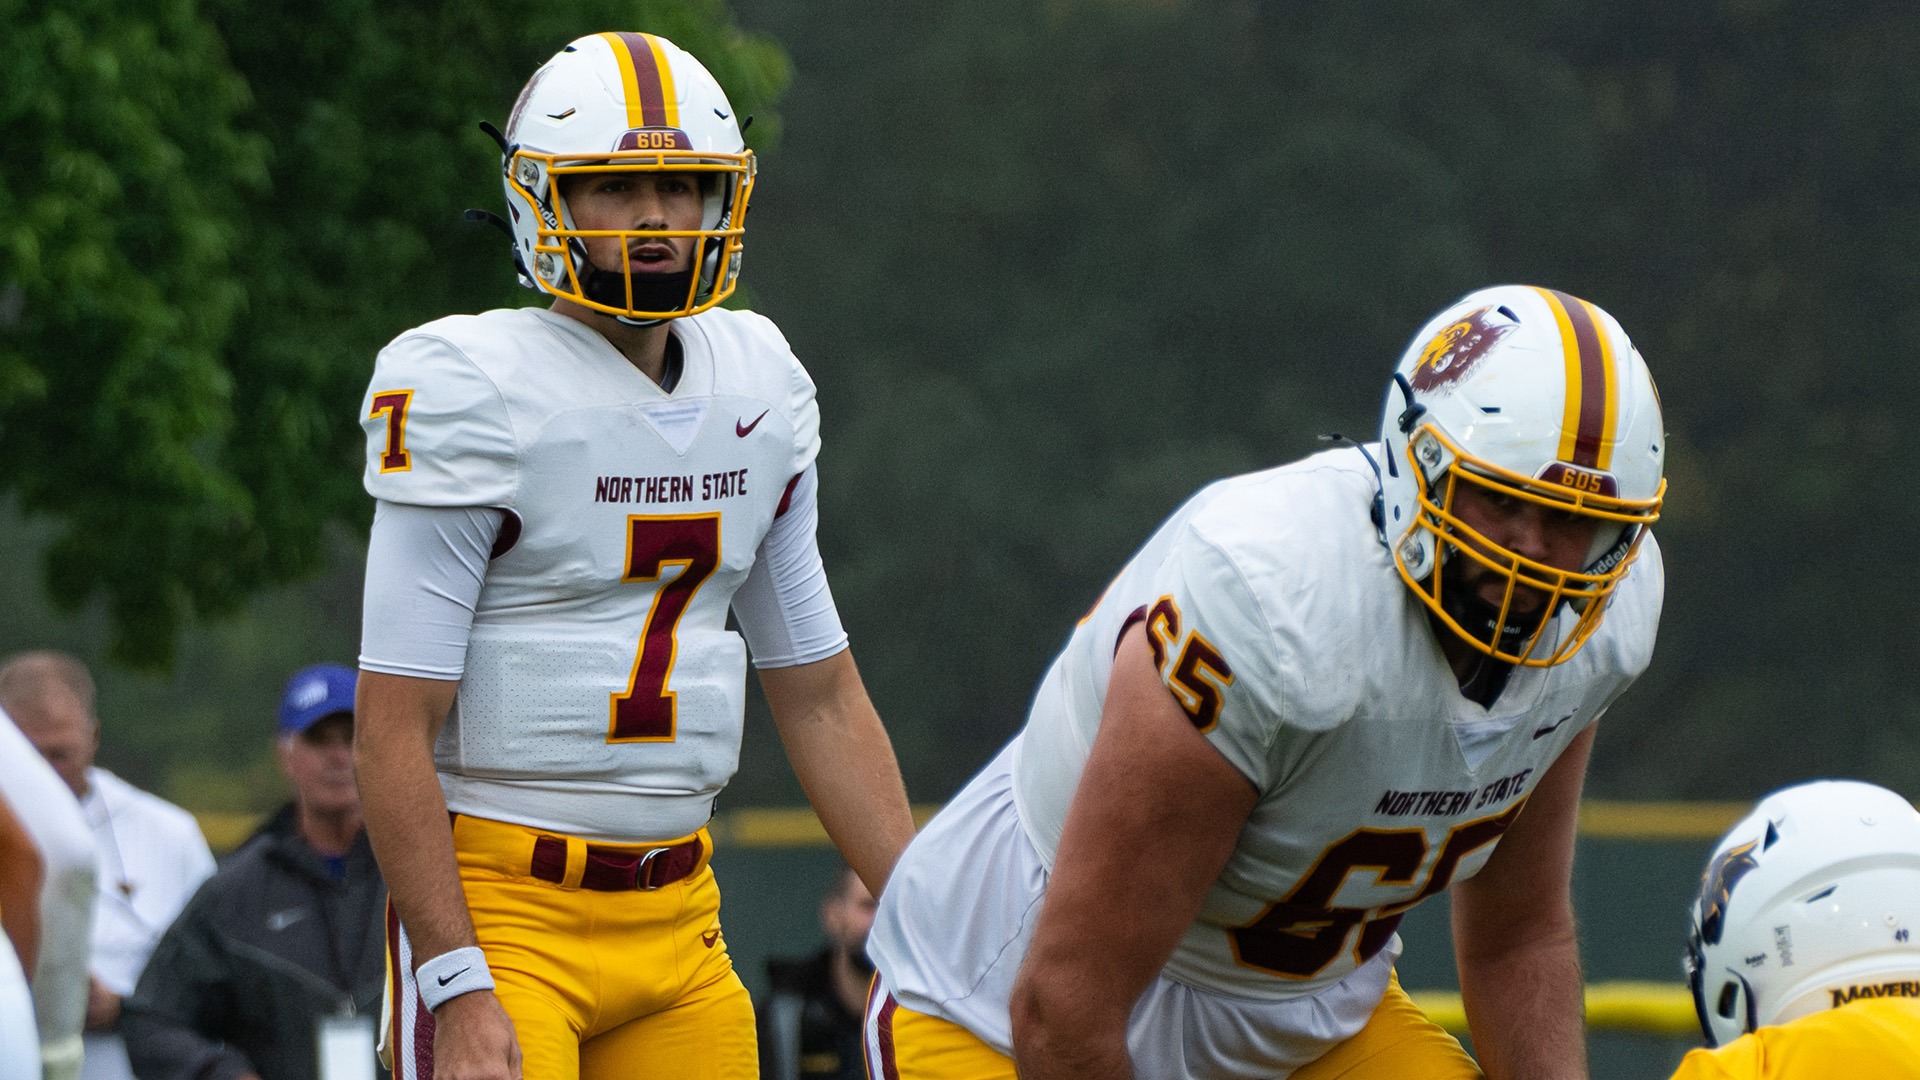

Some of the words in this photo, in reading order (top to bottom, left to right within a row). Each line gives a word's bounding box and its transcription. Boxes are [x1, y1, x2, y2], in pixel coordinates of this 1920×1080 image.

[636, 132, 676, 149] 605
[369, 389, 415, 474] 7
[595, 475, 694, 503] NORTHERN
[702, 468, 748, 501] STATE
[1562, 467, 1603, 493] 605
[605, 511, 722, 744] 7
[1374, 789, 1478, 817] NORTHERN
[1475, 768, 1534, 810] STATE
